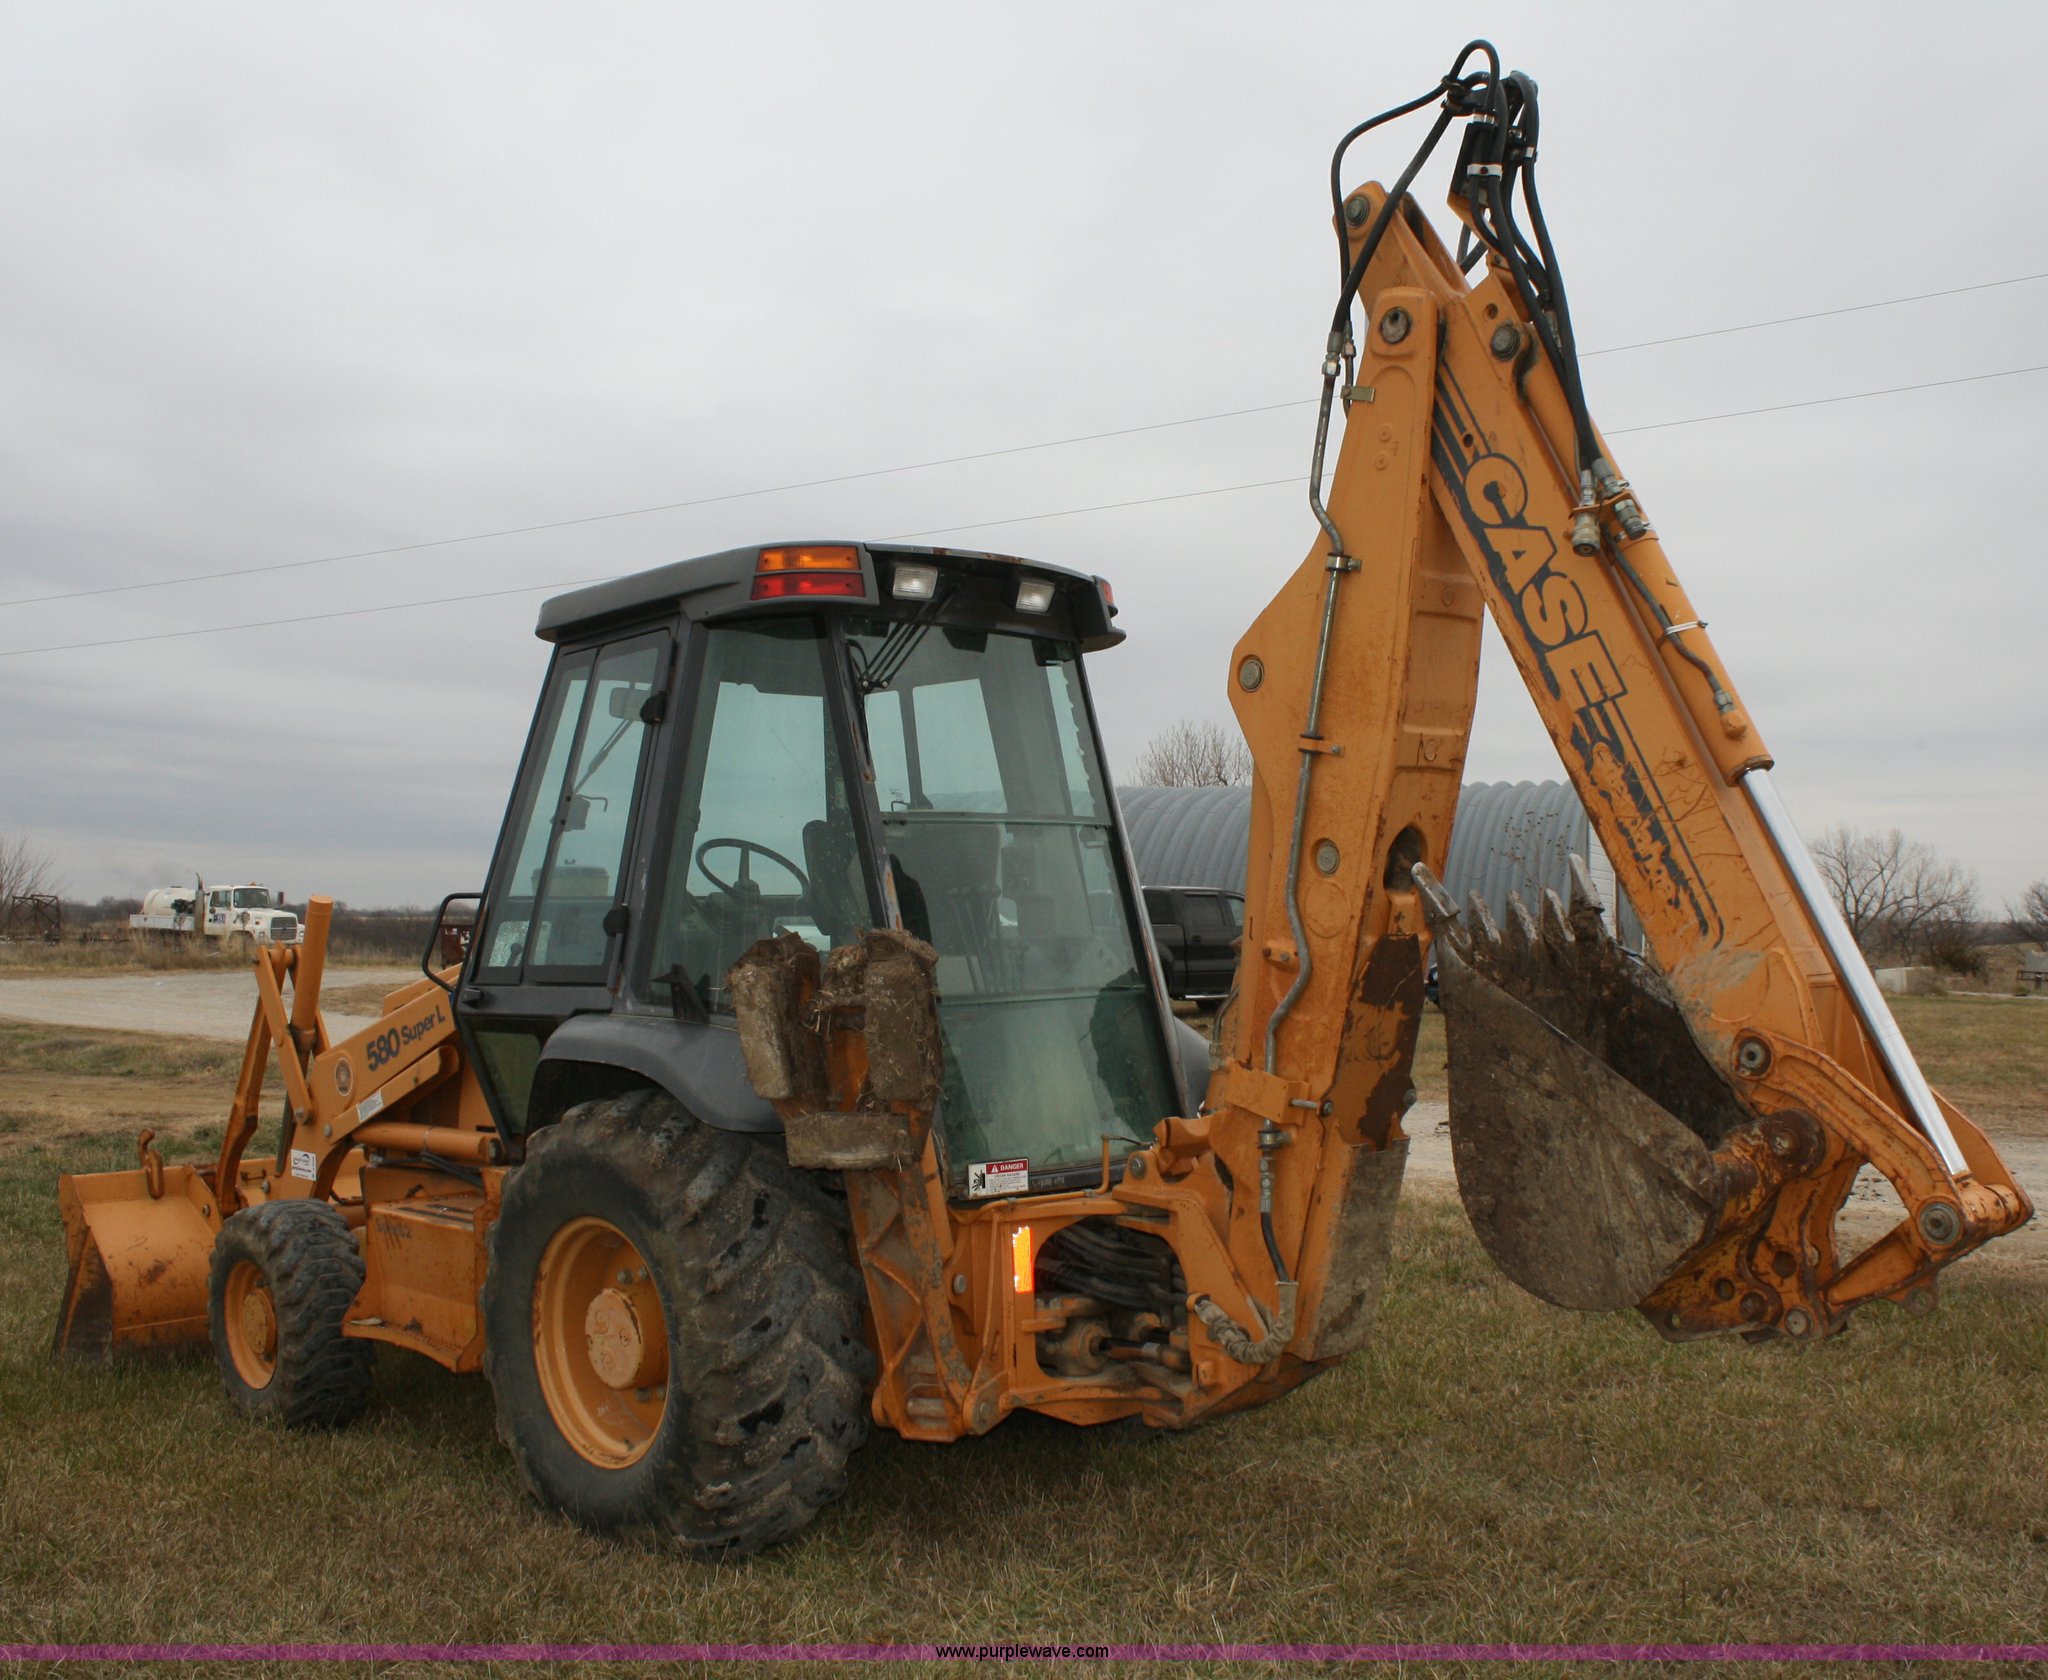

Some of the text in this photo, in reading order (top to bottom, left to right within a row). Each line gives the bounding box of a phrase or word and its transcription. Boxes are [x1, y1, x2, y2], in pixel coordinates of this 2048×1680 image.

[1463, 452, 1629, 706] CASE
[366, 1004, 446, 1071] 580 Super L
[1000, 1162, 1024, 1171] DANGER
